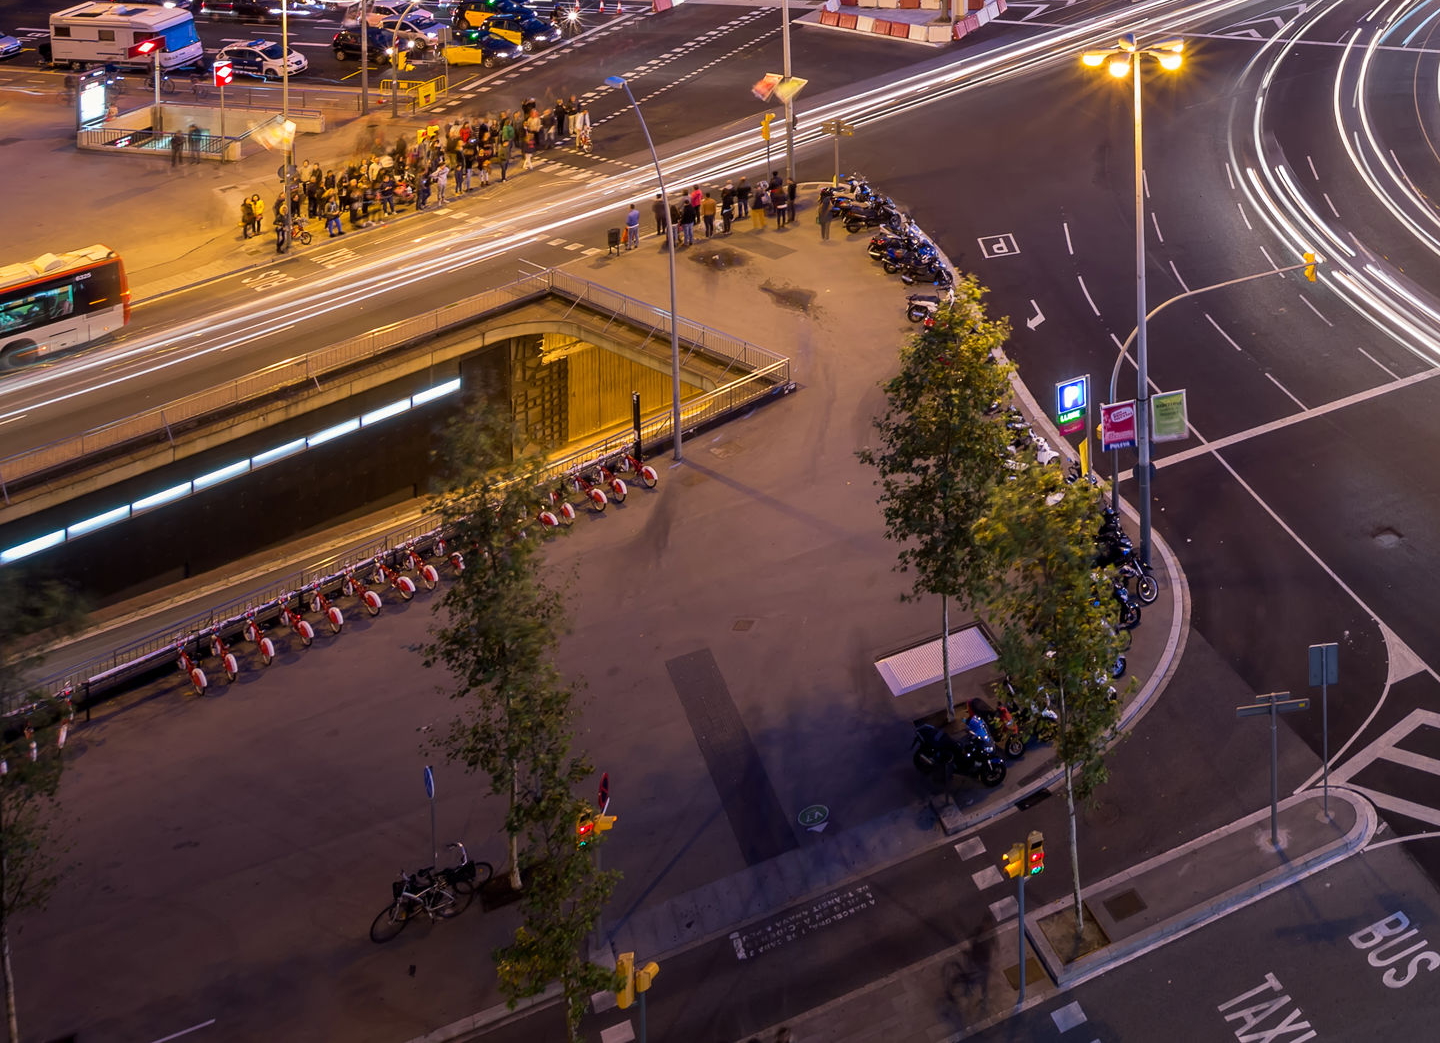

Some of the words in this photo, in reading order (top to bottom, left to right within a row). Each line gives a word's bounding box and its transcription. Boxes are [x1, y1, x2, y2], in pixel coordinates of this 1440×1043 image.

[992, 237, 1009, 254] P
[241, 269, 297, 292] BUS
[1063, 385, 1080, 409] P
